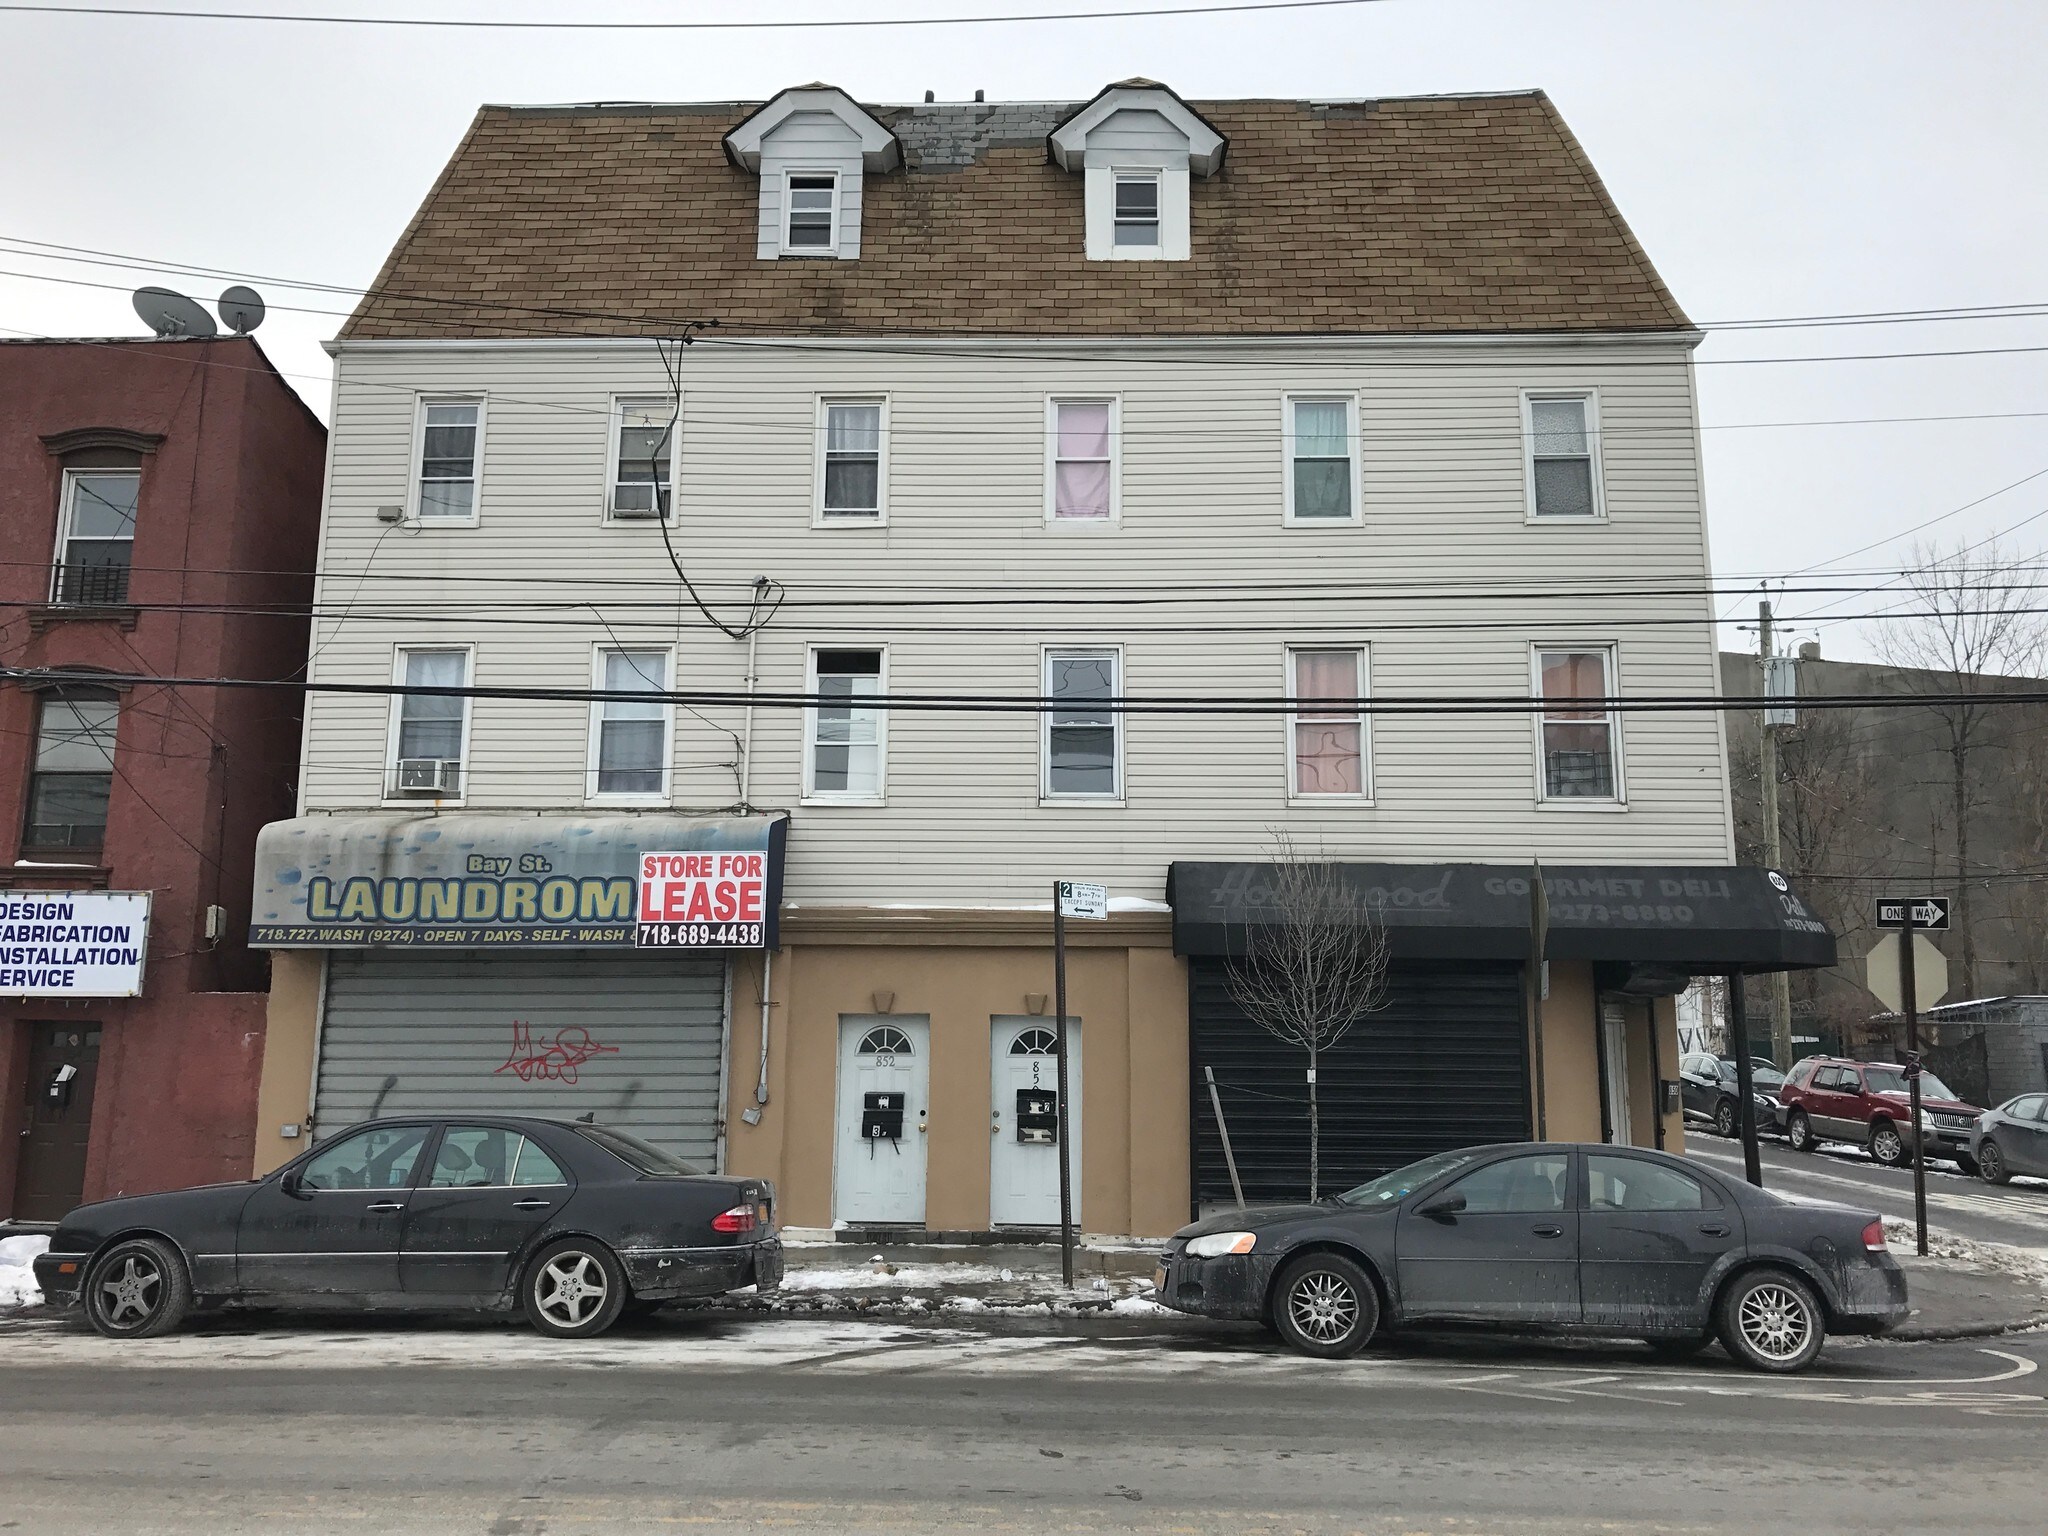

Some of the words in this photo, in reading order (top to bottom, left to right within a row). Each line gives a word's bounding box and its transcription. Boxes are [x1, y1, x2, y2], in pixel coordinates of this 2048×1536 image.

[468, 854, 511, 876] Bay
[519, 854, 552, 873] St.
[643, 855, 713, 878] STORE
[719, 855, 763, 878] FOR
[1063, 883, 1071, 897] 2
[1659, 879, 1731, 900] DELI
[306, 876, 637, 923] LAUNDROM
[641, 881, 762, 921] LEASE
[1886, 907, 1905, 919] ONE
[1915, 908, 1938, 920] WAY
[0, 925, 130, 943] ABRICATION
[257, 928, 363, 941] 718.727.WASH
[368, 929, 415, 944] (9274)
[423, 930, 467, 942] OPEN
[471, 930, 480, 941] 7
[483, 930, 523, 942] DAYS
[532, 929, 571, 941] SELF
[579, 929, 625, 941] WASH
[640, 924, 760, 945] 718-689-4438
[0, 947, 138, 965] NSTALLATION
[0, 969, 75, 987] ERVICE
[875, 1055, 896, 1067] 852
[873, 1127, 880, 1136] 3
